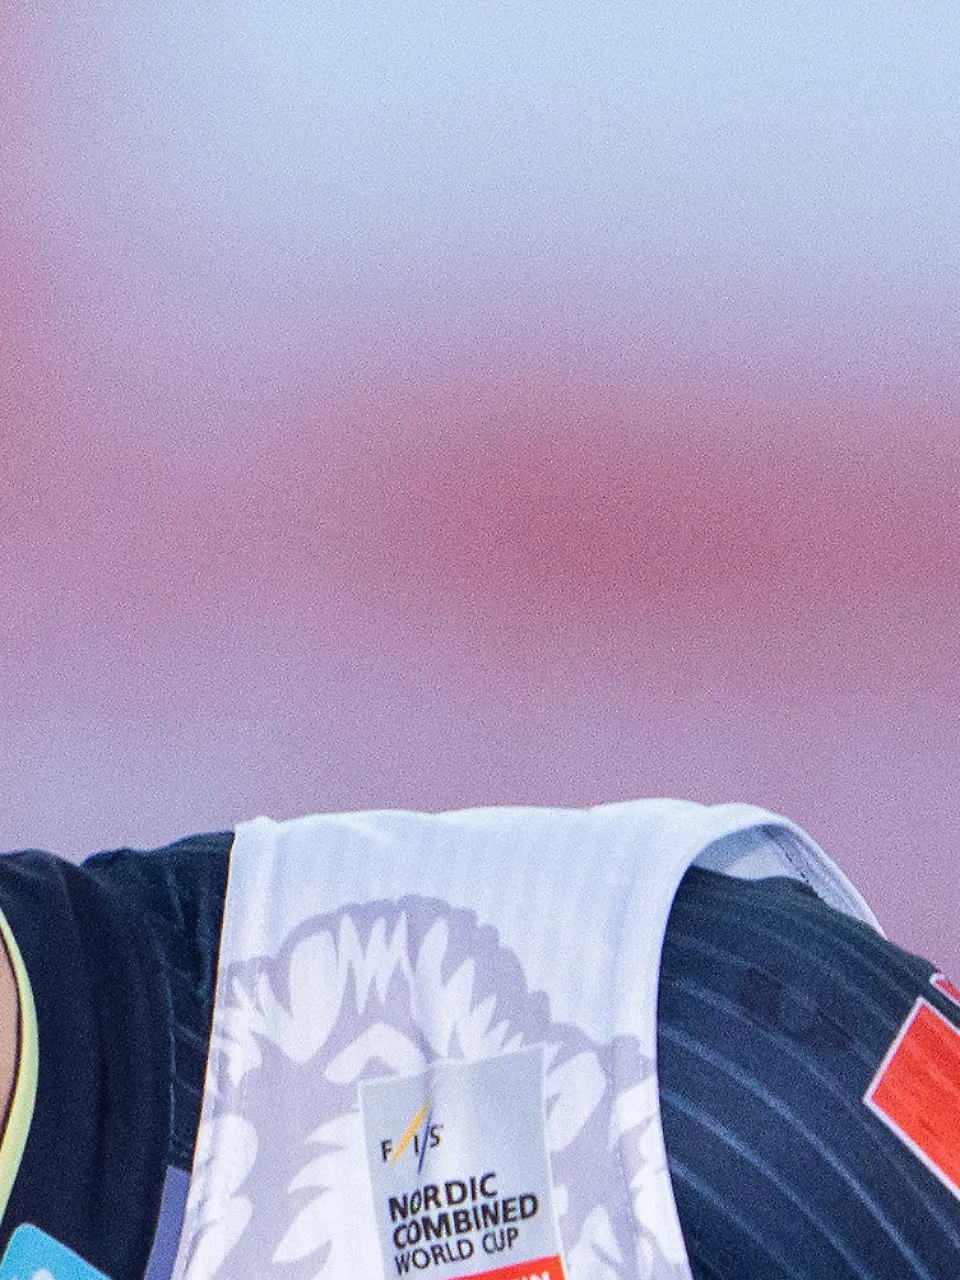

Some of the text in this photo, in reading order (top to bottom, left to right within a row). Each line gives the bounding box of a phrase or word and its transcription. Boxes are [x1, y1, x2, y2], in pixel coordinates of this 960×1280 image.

[388, 1172, 498, 1222] NORDIC
[393, 1192, 539, 1250] COMBINED
[394, 1227, 520, 1276] WORLD CUP
